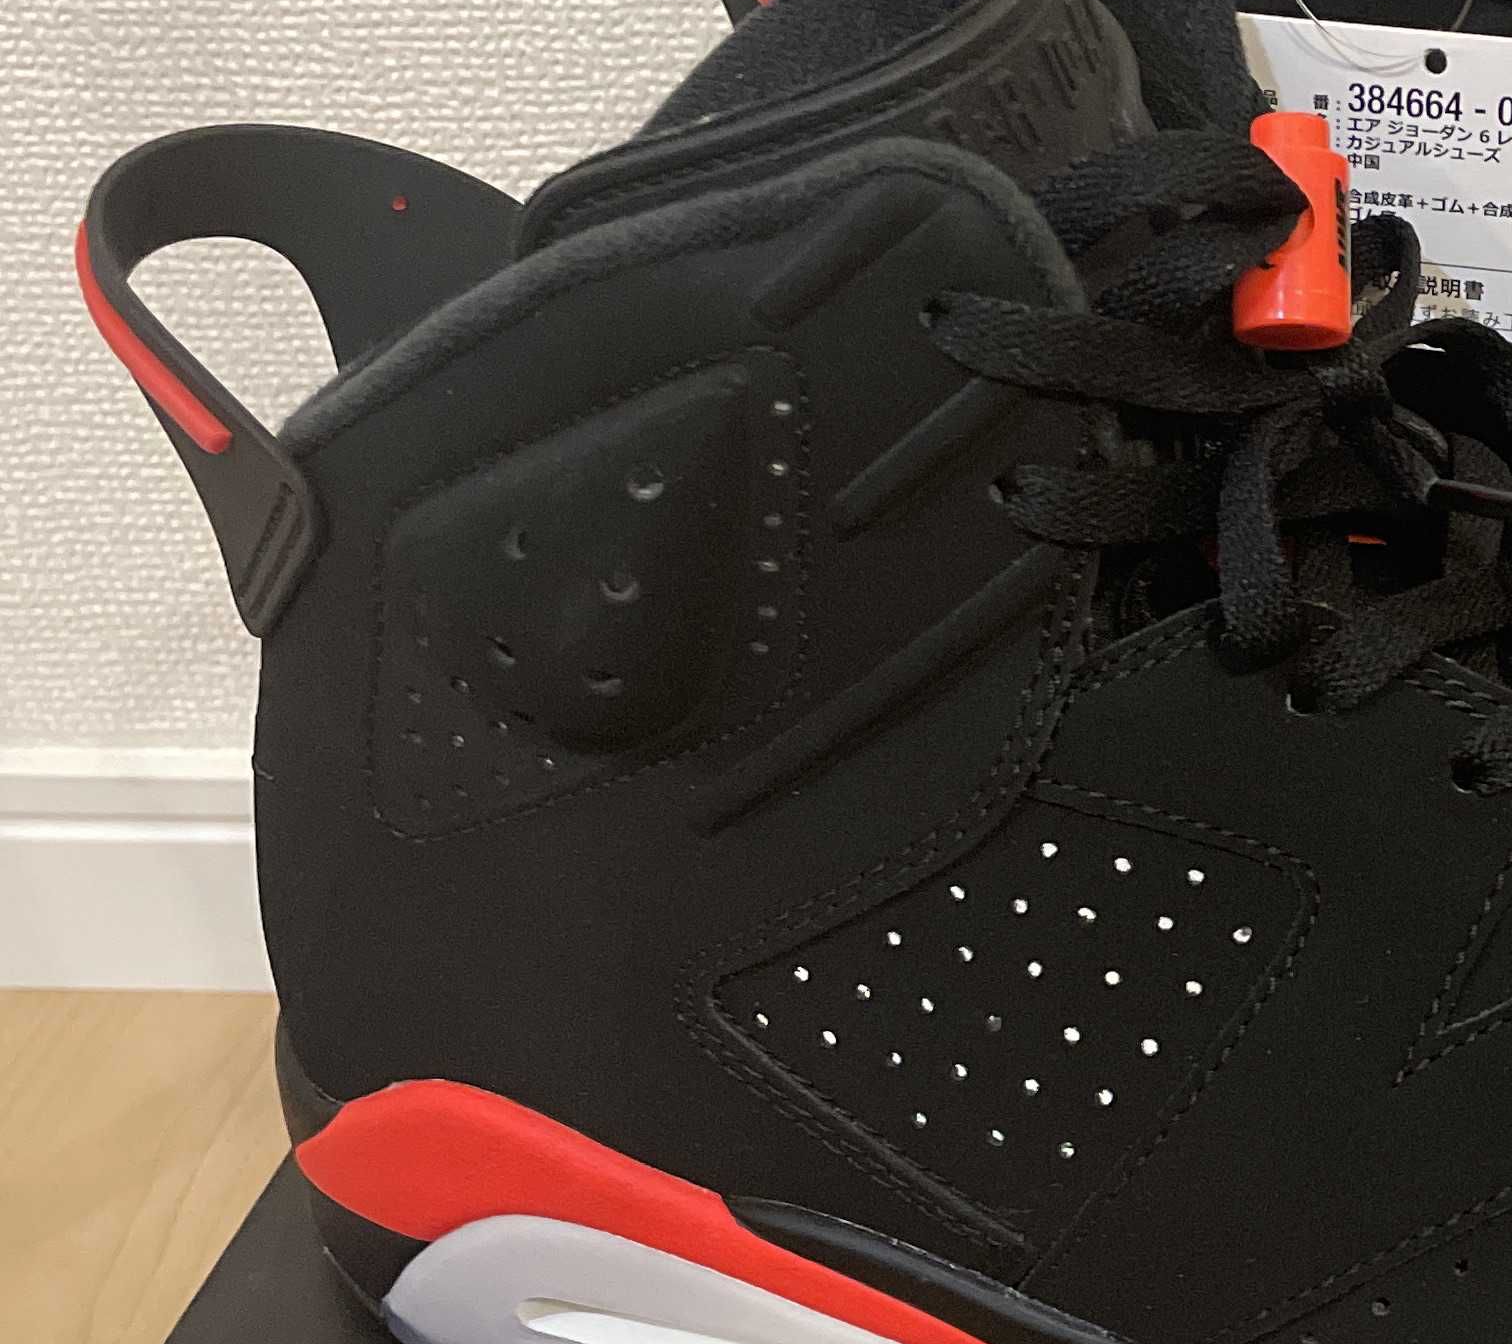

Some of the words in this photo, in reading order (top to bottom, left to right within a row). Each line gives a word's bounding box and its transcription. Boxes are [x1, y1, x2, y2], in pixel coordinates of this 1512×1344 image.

[1347, 83, 1463, 122] 384664
[1347, 117, 1381, 133] エア
[1387, 120, 1473, 143] ジョーダン
[1479, 130, 1490, 144] 6
[1346, 135, 1501, 163] カジュアルシューズ
[1347, 153, 1380, 170] 中国
